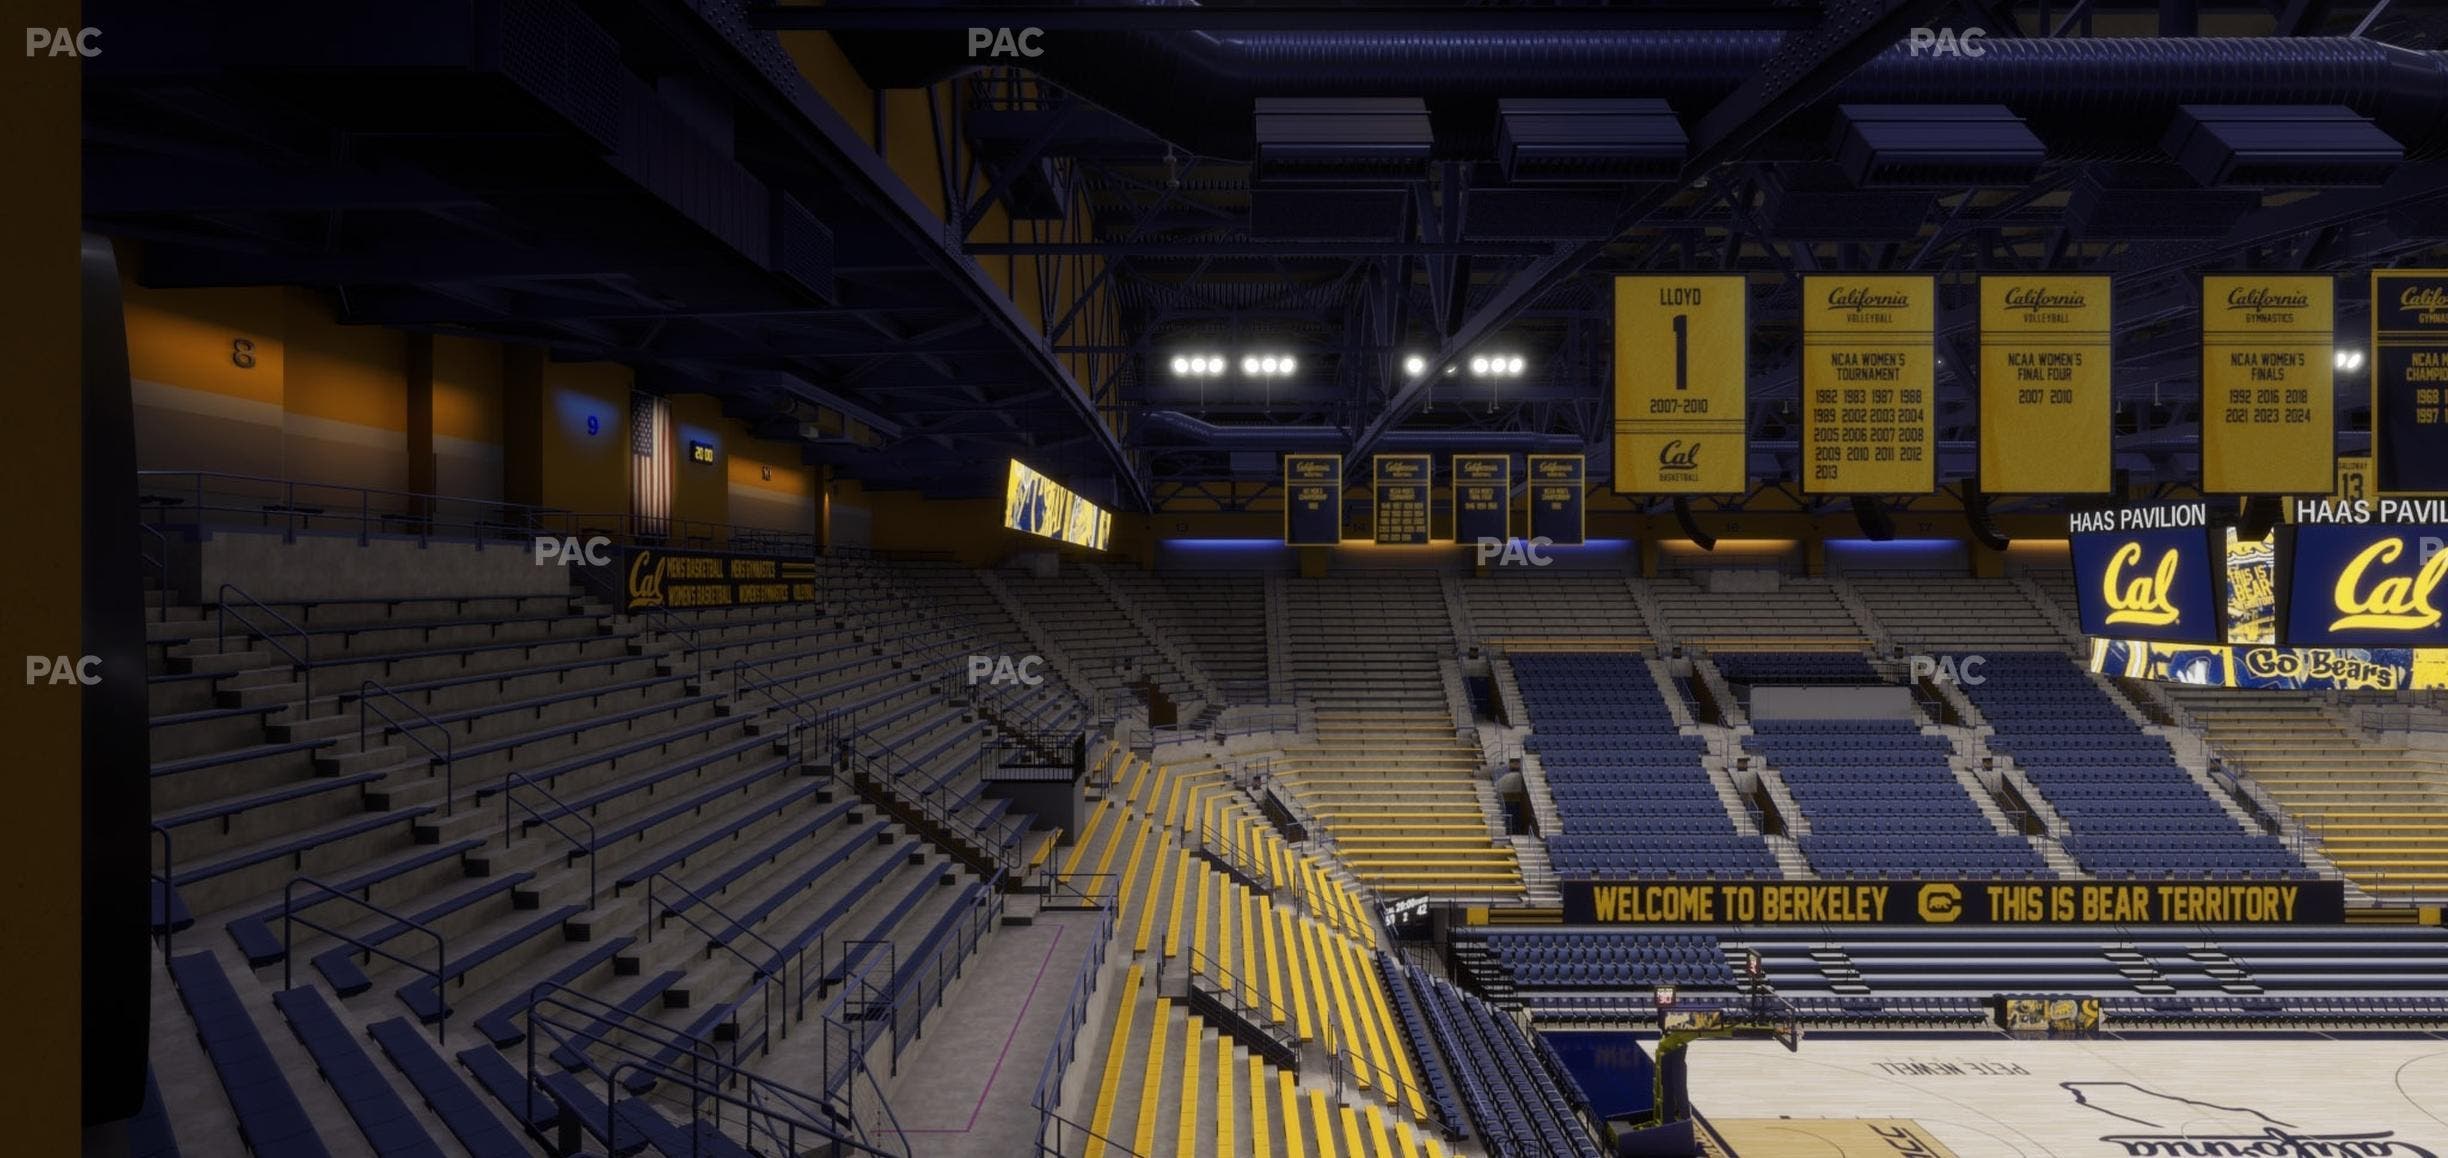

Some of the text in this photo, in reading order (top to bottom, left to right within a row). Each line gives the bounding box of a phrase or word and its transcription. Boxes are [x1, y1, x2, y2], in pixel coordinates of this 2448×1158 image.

[1660, 288, 1701, 306] LLOYD
[1828, 288, 1908, 314] California
[2005, 287, 2086, 312] California
[2227, 287, 2309, 312] California
[1847, 313, 1892, 323] VOLLEYBALL
[2024, 313, 2069, 323] VOLLEYBALL
[2246, 313, 2294, 323] GYMNASTICS
[233, 338, 256, 369] 8
[1673, 315, 1687, 389] 1
[1832, 353, 1905, 366] NCAA WOMEN'S
[2008, 354, 2082, 366] NCAA WOMEN'S
[2230, 354, 2304, 366] NCAA WOMEN'S
[2412, 354, 2439, 367] NCAA
[1837, 368, 1899, 380] TOURNAMENT
[2018, 368, 2072, 381] FINAL FOUR
[2252, 368, 2284, 381] FINALS
[1816, 390, 1922, 402] 1982 1983 1987 1988
[2019, 390, 2072, 404] 2007 2010
[2229, 390, 2307, 404] 1992 2016 2018
[1650, 399, 1708, 413] 2007-2010
[1814, 409, 1924, 422] 1989 2002 2003 2004
[2226, 409, 2310, 423] 2021 2023 2024
[2416, 409, 2438, 423] 1997
[587, 416, 599, 435] 9
[1814, 429, 1923, 441] 2005 2006 2007 2008
[1659, 440, 1700, 469] Cal
[1816, 448, 1922, 461] 2009 2010 2011 2012
[1659, 473, 1699, 481] BASKETBALL
[1816, 466, 1837, 479] 2013
[2342, 473, 2363, 502] 13
[2070, 503, 2206, 533] HAAS PAVILION
[2298, 501, 2370, 523] HAAS
[627, 550, 666, 608] Cal
[2103, 541, 2180, 626] Cal
[2329, 537, 2448, 632] Cal
[2248, 649, 2392, 687] Go Bears
[1594, 886, 1889, 922] WELCOME TO BERKELEY
[1988, 886, 2298, 922] THIS IS BEAR TERRITORY
[1871, 1063, 2031, 1075] PETE NEWELL
